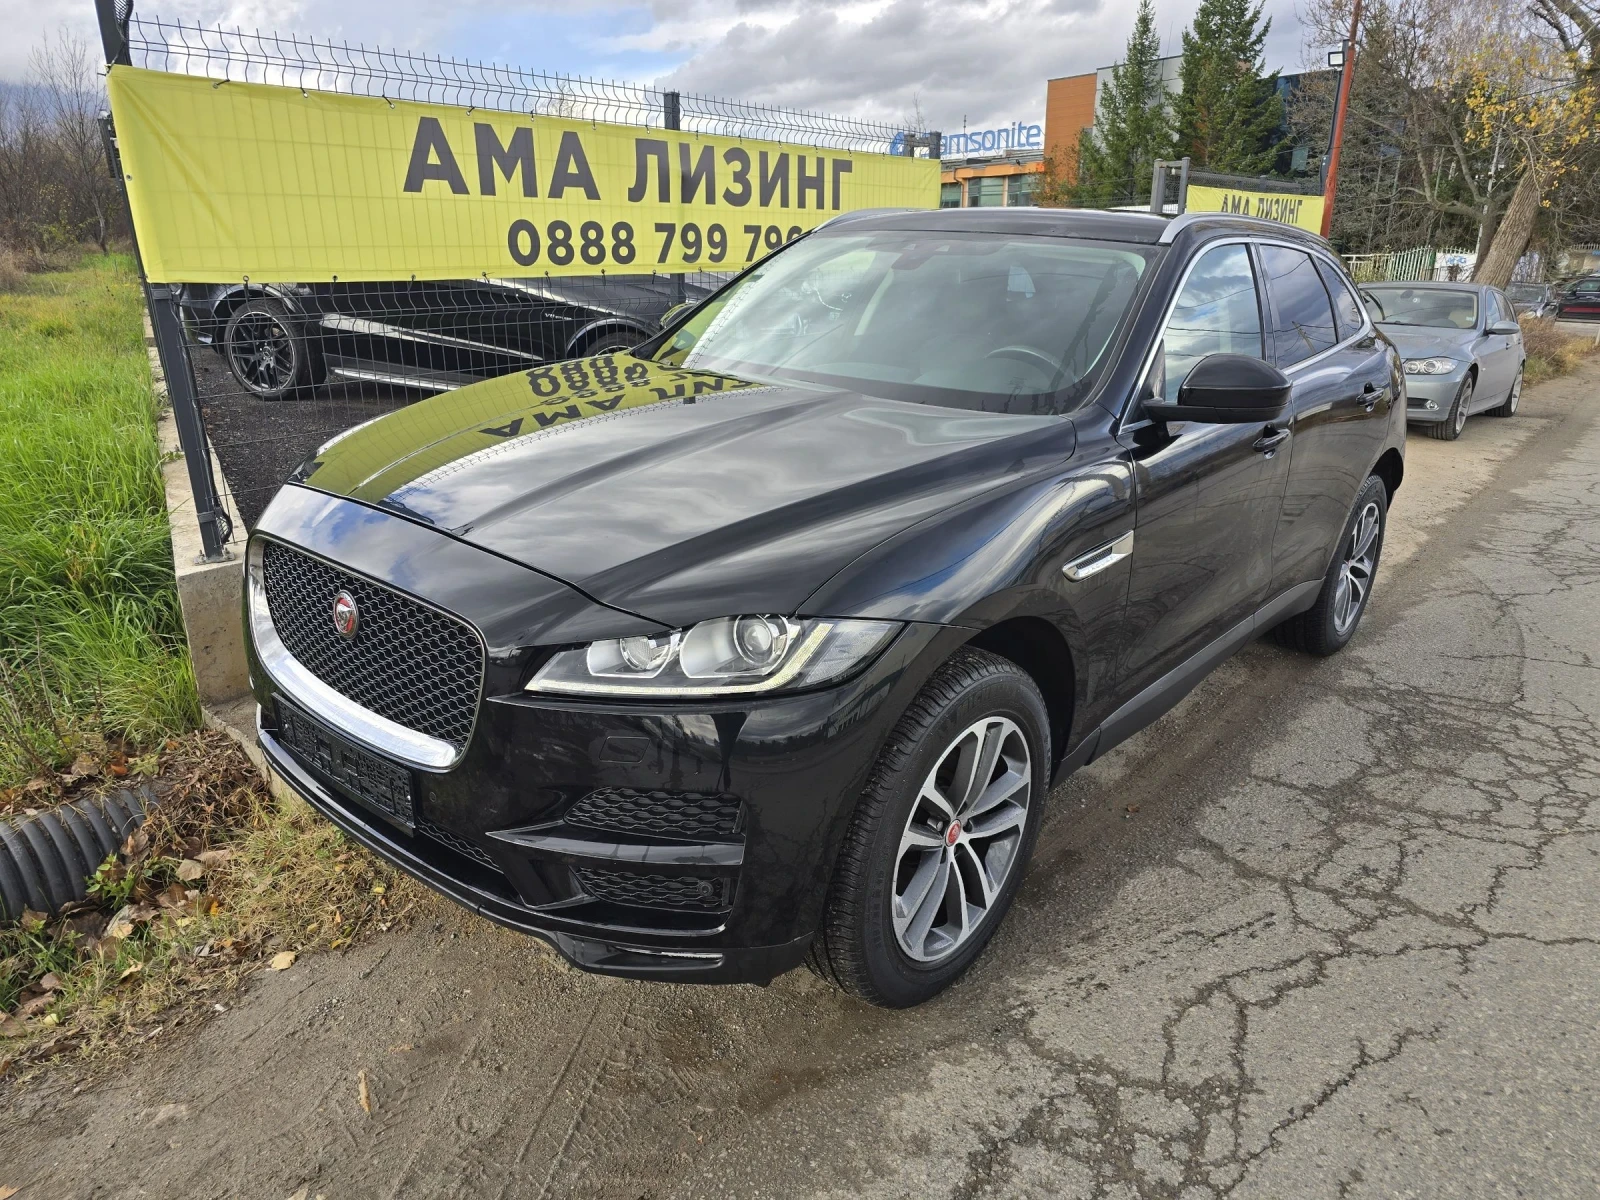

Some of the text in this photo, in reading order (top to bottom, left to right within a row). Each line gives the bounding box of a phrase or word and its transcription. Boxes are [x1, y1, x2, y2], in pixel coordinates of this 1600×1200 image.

[920, 121, 1041, 157] amsonite
[403, 116, 853, 211] АМА ЛИЗИНГ
[1221, 194, 1303, 224] АМА ЛИЗИНГ
[506, 219, 637, 267] 0888
[654, 222, 729, 264] 799
